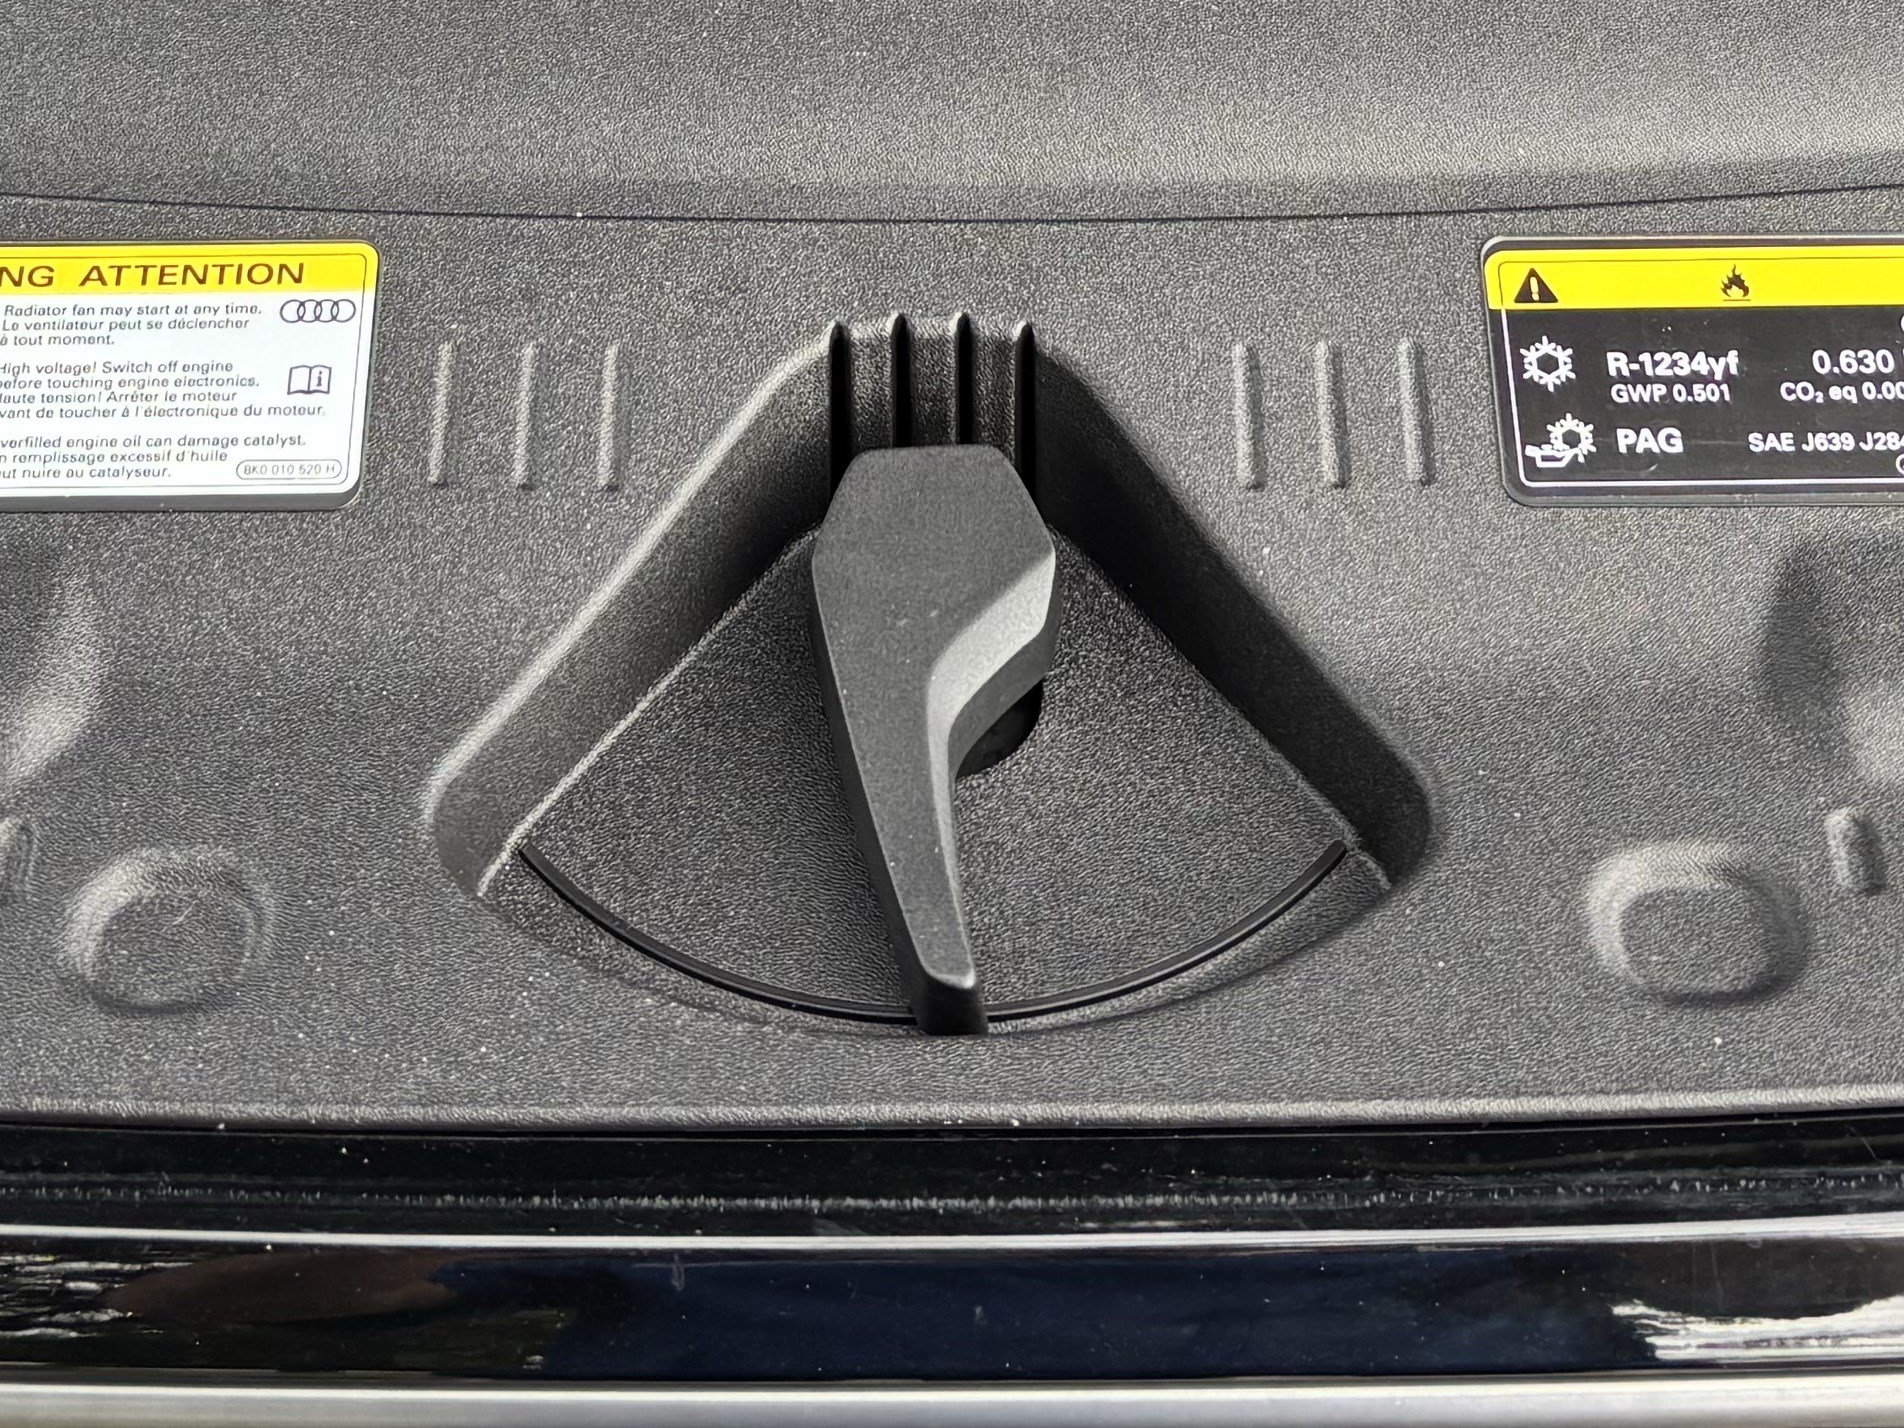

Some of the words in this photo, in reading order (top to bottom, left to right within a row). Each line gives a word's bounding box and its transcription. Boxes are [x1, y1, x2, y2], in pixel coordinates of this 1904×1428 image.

[79, 262, 305, 287] ATTENTION
[4, 304, 67, 317] Radiator
[72, 304, 95, 317] fan
[100, 306, 132, 318] may
[137, 305, 171, 316] start
[174, 305, 189, 316] at
[193, 305, 220, 318] any
[225, 302, 262, 315] time.
[2, 319, 20, 332] Le
[24, 318, 104, 331] ventilateur
[108, 319, 142, 332] peut
[146, 320, 163, 330] se
[168, 318, 249, 330] déclencher
[13, 334, 43, 346] tout
[48, 334, 115, 346] moment.
[36, 362, 97, 376] voltage!
[102, 360, 153, 374] Switch
[157, 360, 179, 373] off
[182, 362, 234, 375] engine
[1607, 349, 1741, 377] R-1234yf
[1812, 349, 1896, 375] 0.630
[47, 376, 113, 391] touching
[118, 376, 169, 391] engine
[174, 375, 260, 388] electronics.
[41, 391, 103, 404] tension!
[164, 391, 178, 403] le
[182, 391, 238, 402] moteur
[1610, 382, 1666, 404] GWP
[1672, 382, 1732, 404] 0.501
[1828, 384, 1858, 404] eq
[35, 406, 54, 419] de
[59, 406, 117, 419] toucher
[244, 404, 263, 417] du
[67, 436, 118, 450] engine
[122, 435, 142, 447] oil
[146, 436, 172, 447] can
[177, 435, 239, 449] damage
[1617, 428, 1685, 454] PAG
[1748, 431, 1796, 453] SAE
[1801, 431, 1856, 453] J639
[12, 451, 105, 465] remplissage
[110, 450, 172, 463] excessif
[22, 467, 61, 479] nuire
[66, 468, 85, 479] au
[89, 466, 172, 480] catalyseur.
[271, 464, 295, 475] 010
[326, 464, 335, 474] H
